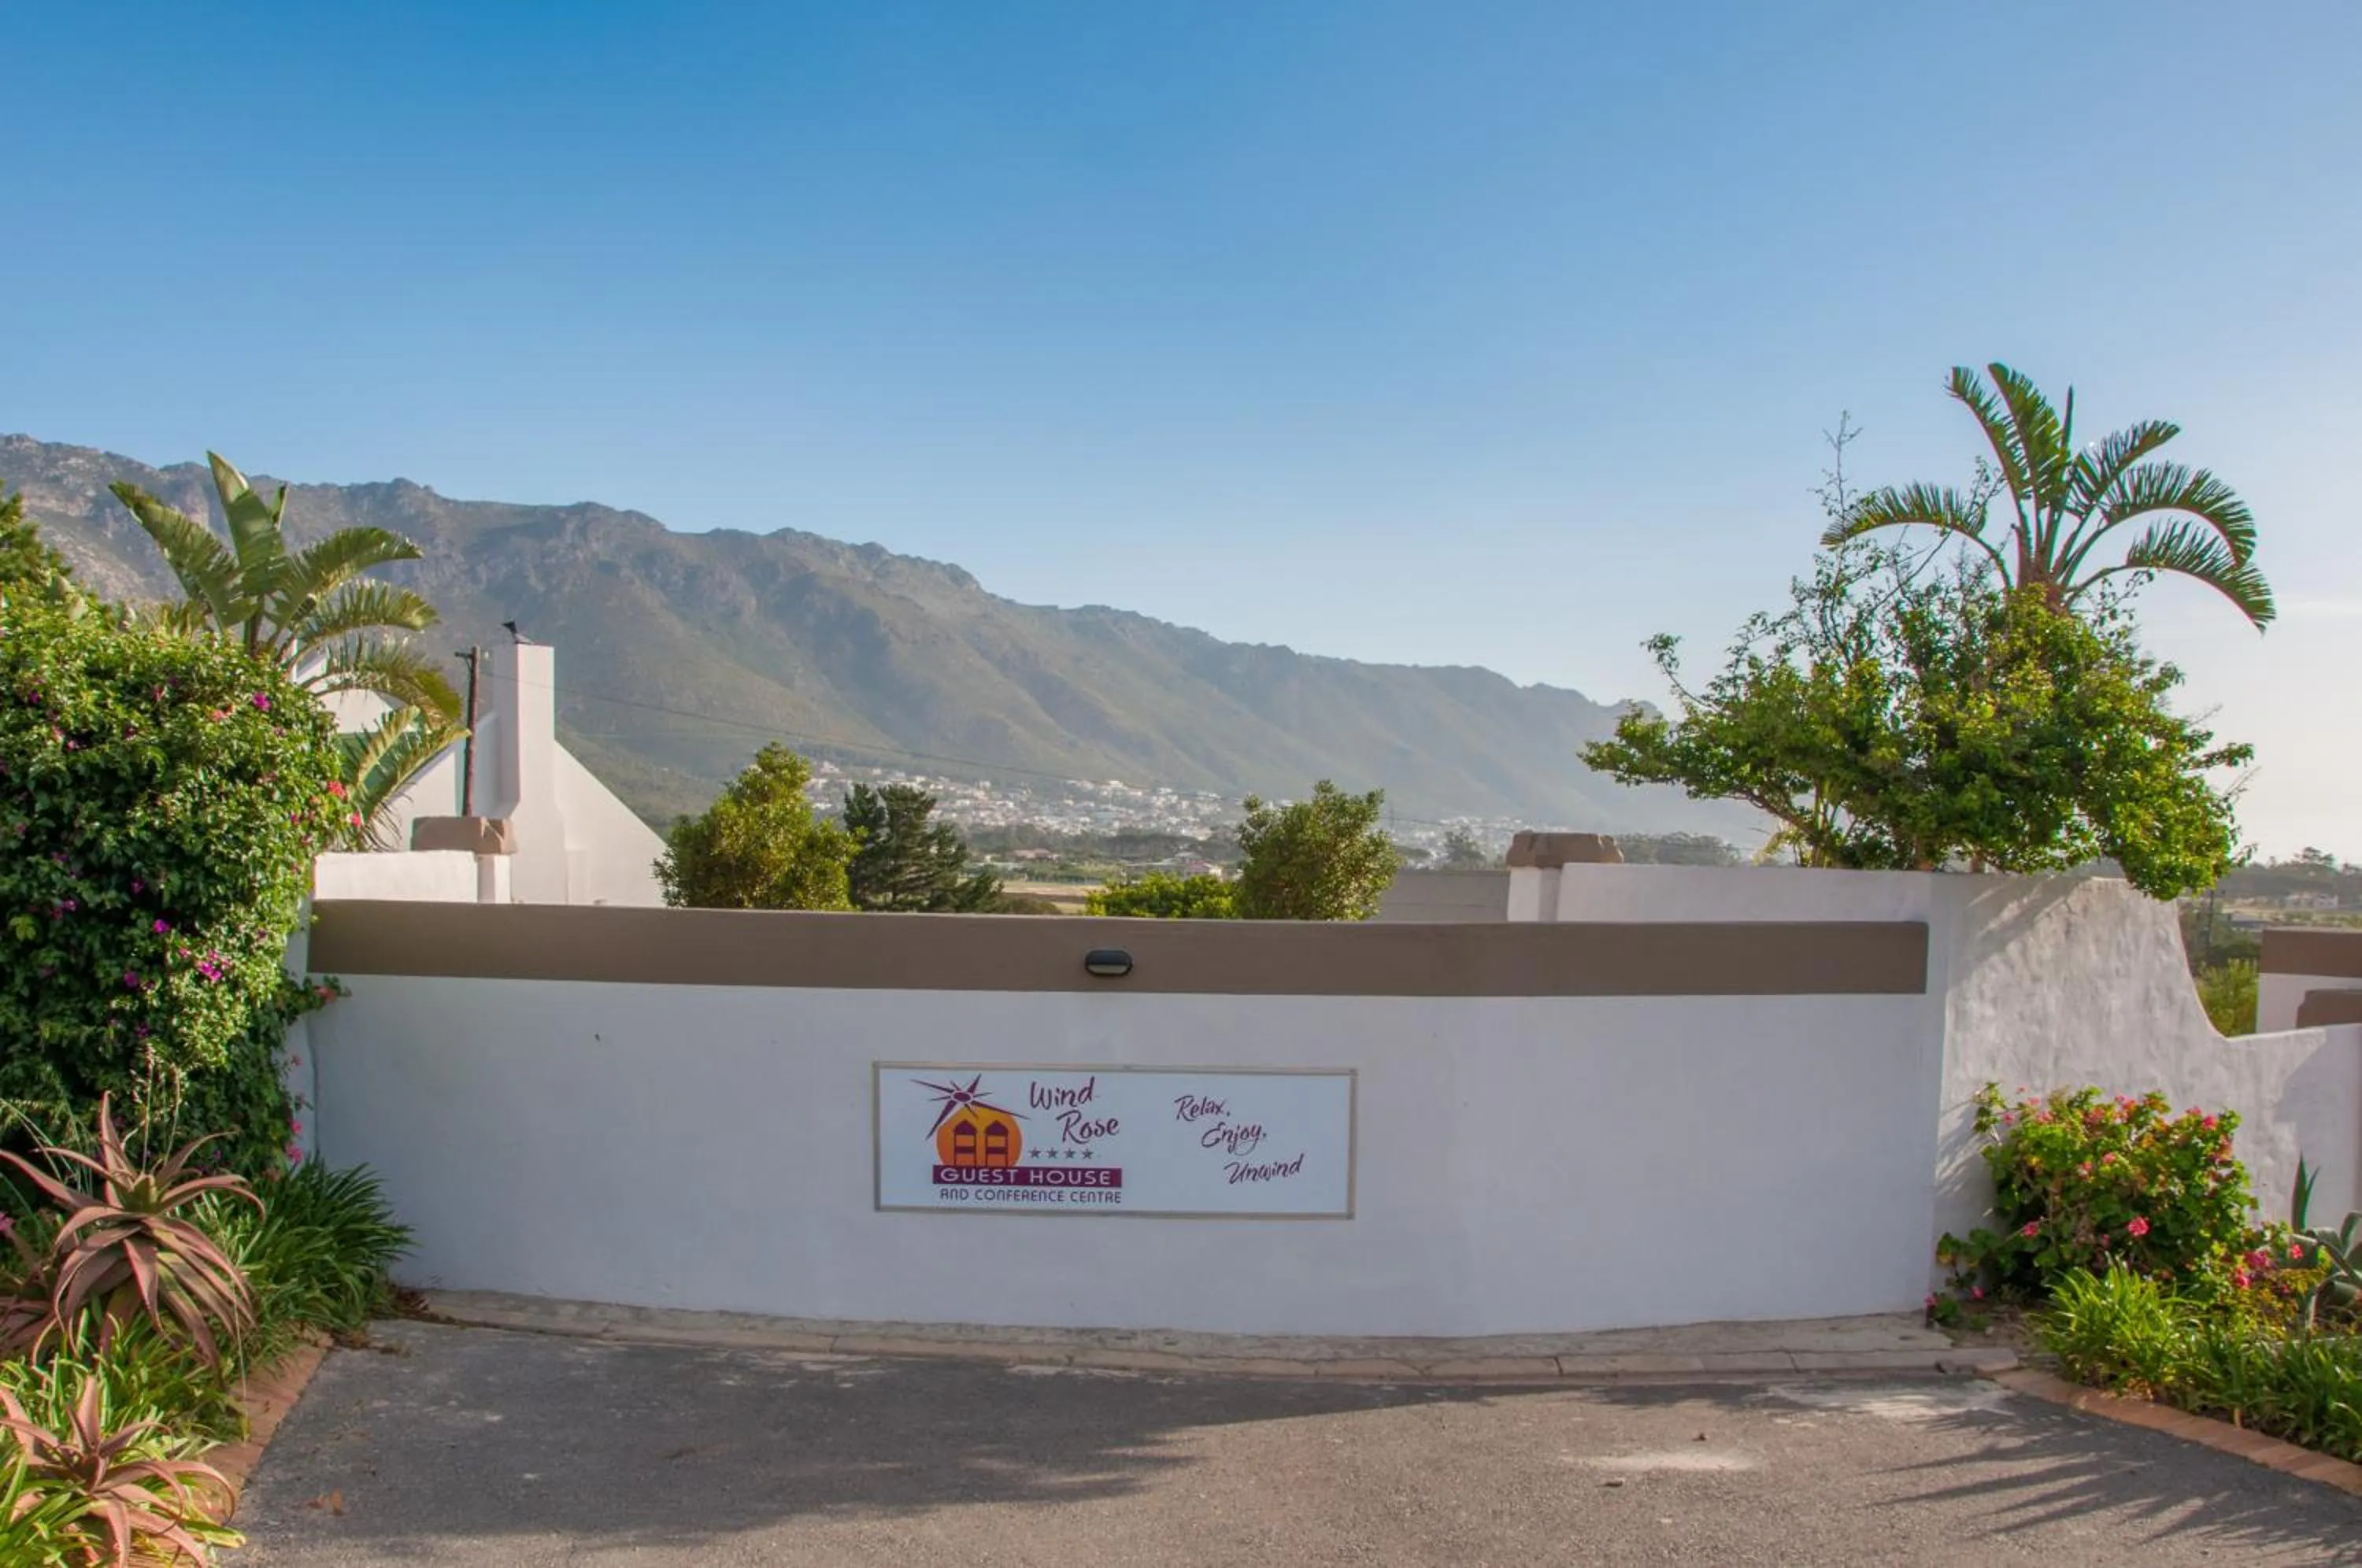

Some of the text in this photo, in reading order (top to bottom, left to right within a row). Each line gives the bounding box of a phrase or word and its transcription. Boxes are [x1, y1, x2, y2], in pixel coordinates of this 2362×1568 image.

[1030, 1075, 1095, 1110] Wind
[1056, 1110, 1120, 1144] Rose
[940, 1168, 1111, 1185] GUEST HOUSE
[1224, 1153, 1304, 1184] Unwind
[940, 1189, 1122, 1204] AND CONFERENCE CENTRE
